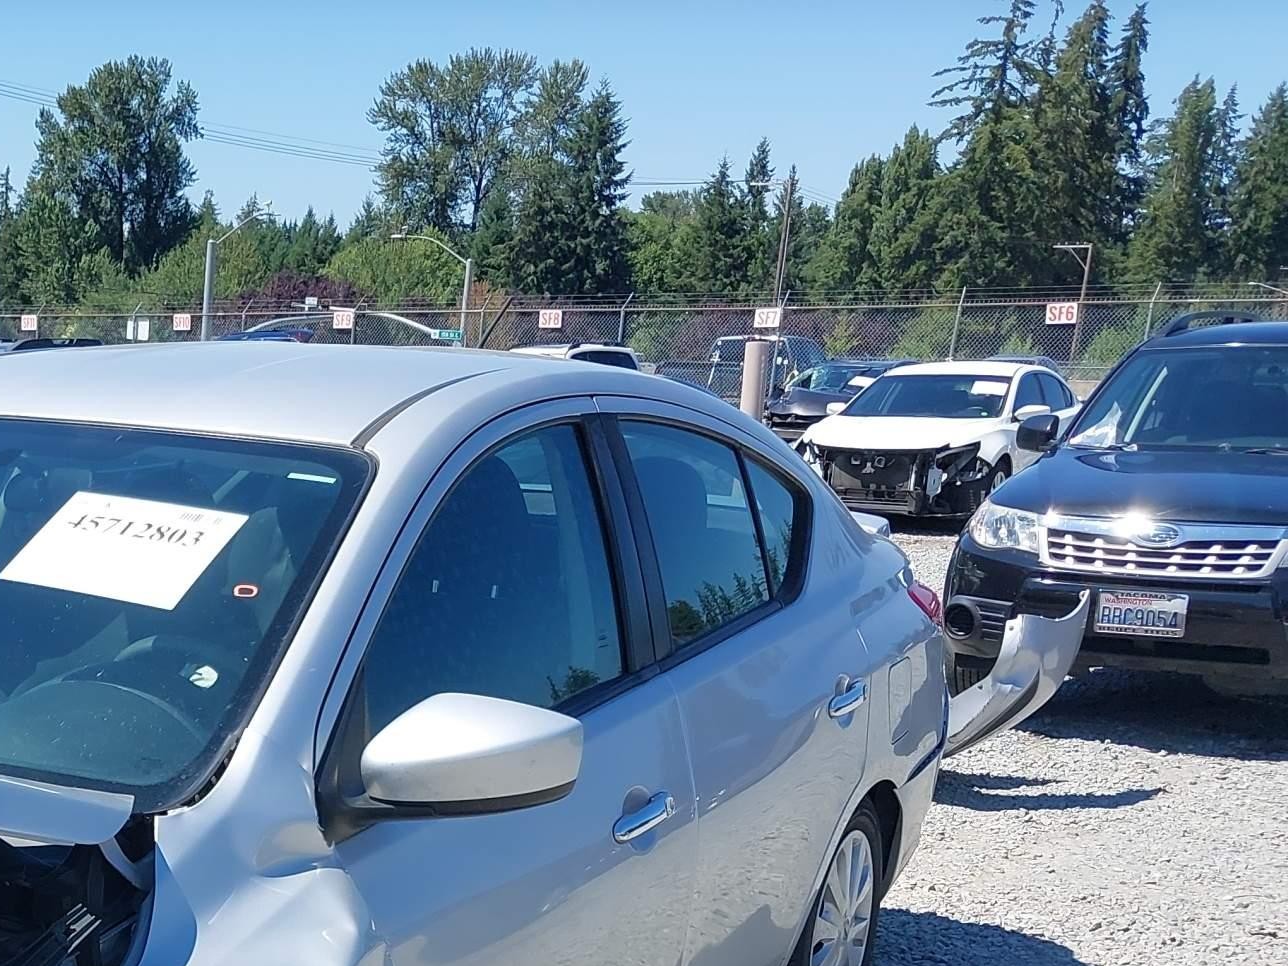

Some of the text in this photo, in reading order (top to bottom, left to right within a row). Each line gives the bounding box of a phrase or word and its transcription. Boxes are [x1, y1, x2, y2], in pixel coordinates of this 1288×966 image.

[541, 311, 560, 326] SF8
[757, 311, 778, 326] SF7
[1048, 305, 1075, 322] SF6
[174, 316, 190, 329] SF10
[334, 314, 351, 328] SF9
[67, 513, 205, 547] 45712803
[1104, 597, 1153, 606] WASHINGTON
[1120, 592, 1166, 600] TACOMA
